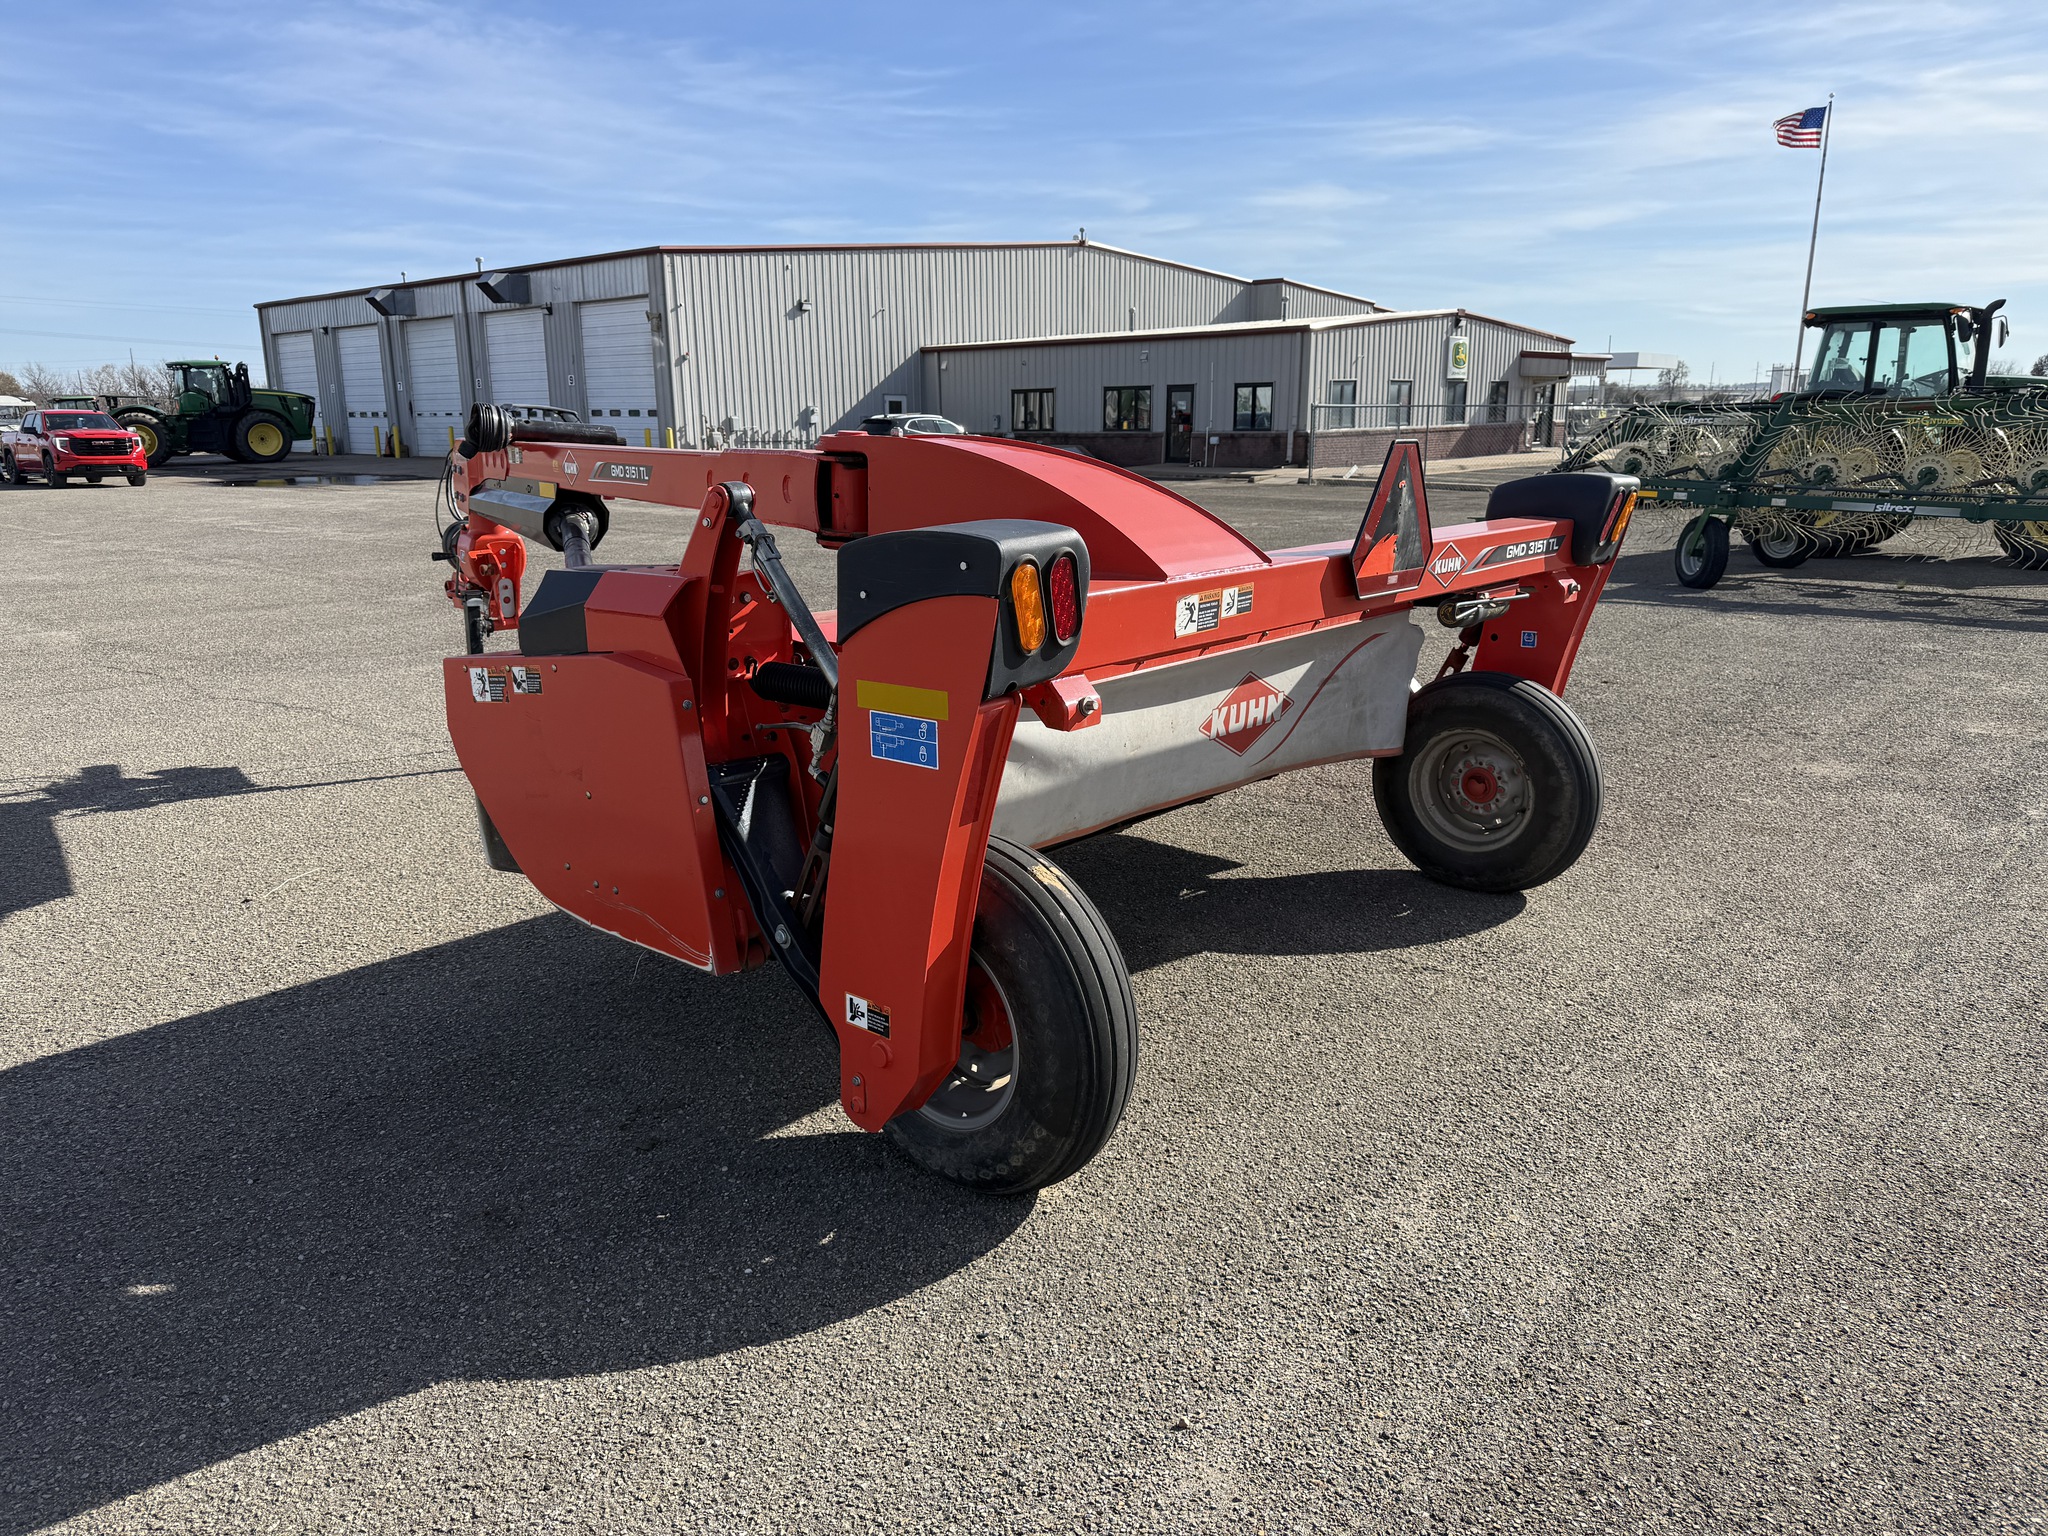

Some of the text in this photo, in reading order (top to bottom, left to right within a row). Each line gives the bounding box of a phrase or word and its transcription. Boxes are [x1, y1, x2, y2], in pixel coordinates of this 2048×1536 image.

[610, 464, 649, 480] GMD 3151 TL
[1875, 502, 1915, 513] sitrex
[1506, 538, 1559, 559] GMD 3151 TL
[1435, 556, 1462, 575] KUHN
[1209, 691, 1284, 740] KUHN
